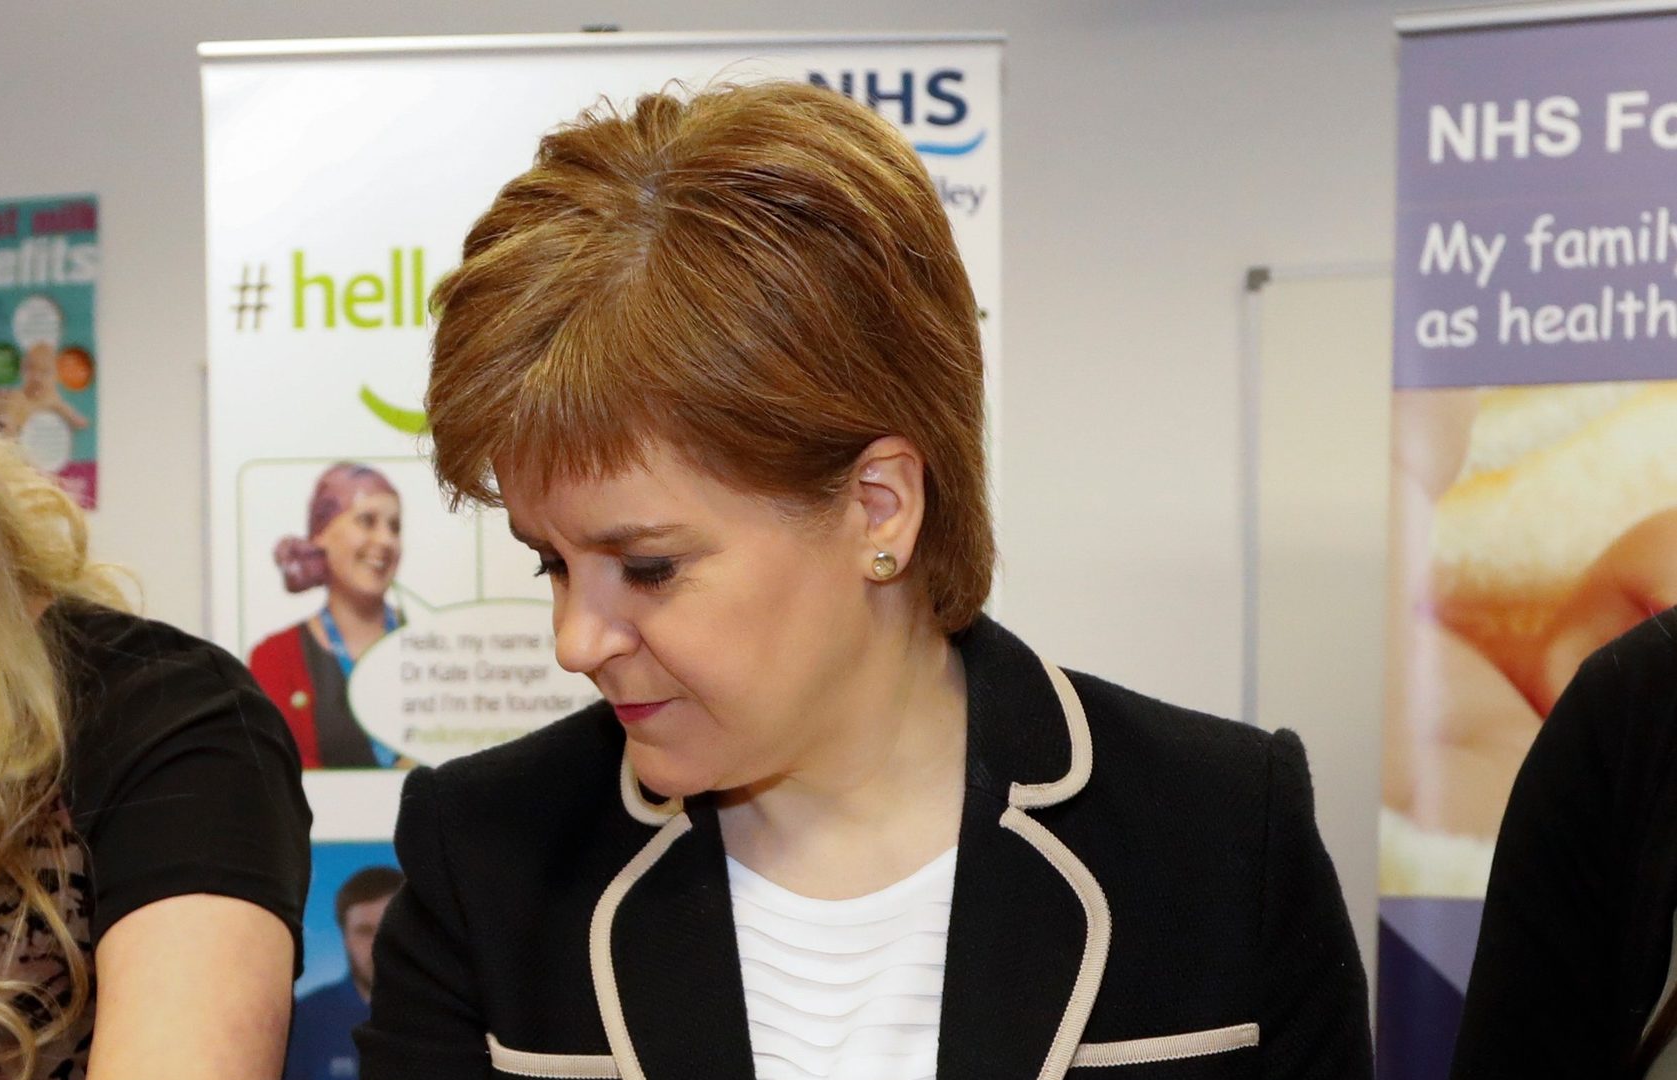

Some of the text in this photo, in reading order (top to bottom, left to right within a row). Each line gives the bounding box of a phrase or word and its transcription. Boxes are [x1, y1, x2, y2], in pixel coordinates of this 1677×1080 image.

[1428, 96, 1582, 164] NHS
[291, 246, 441, 329] hell
[1419, 220, 1506, 289] My
[1415, 305, 1479, 347] as
